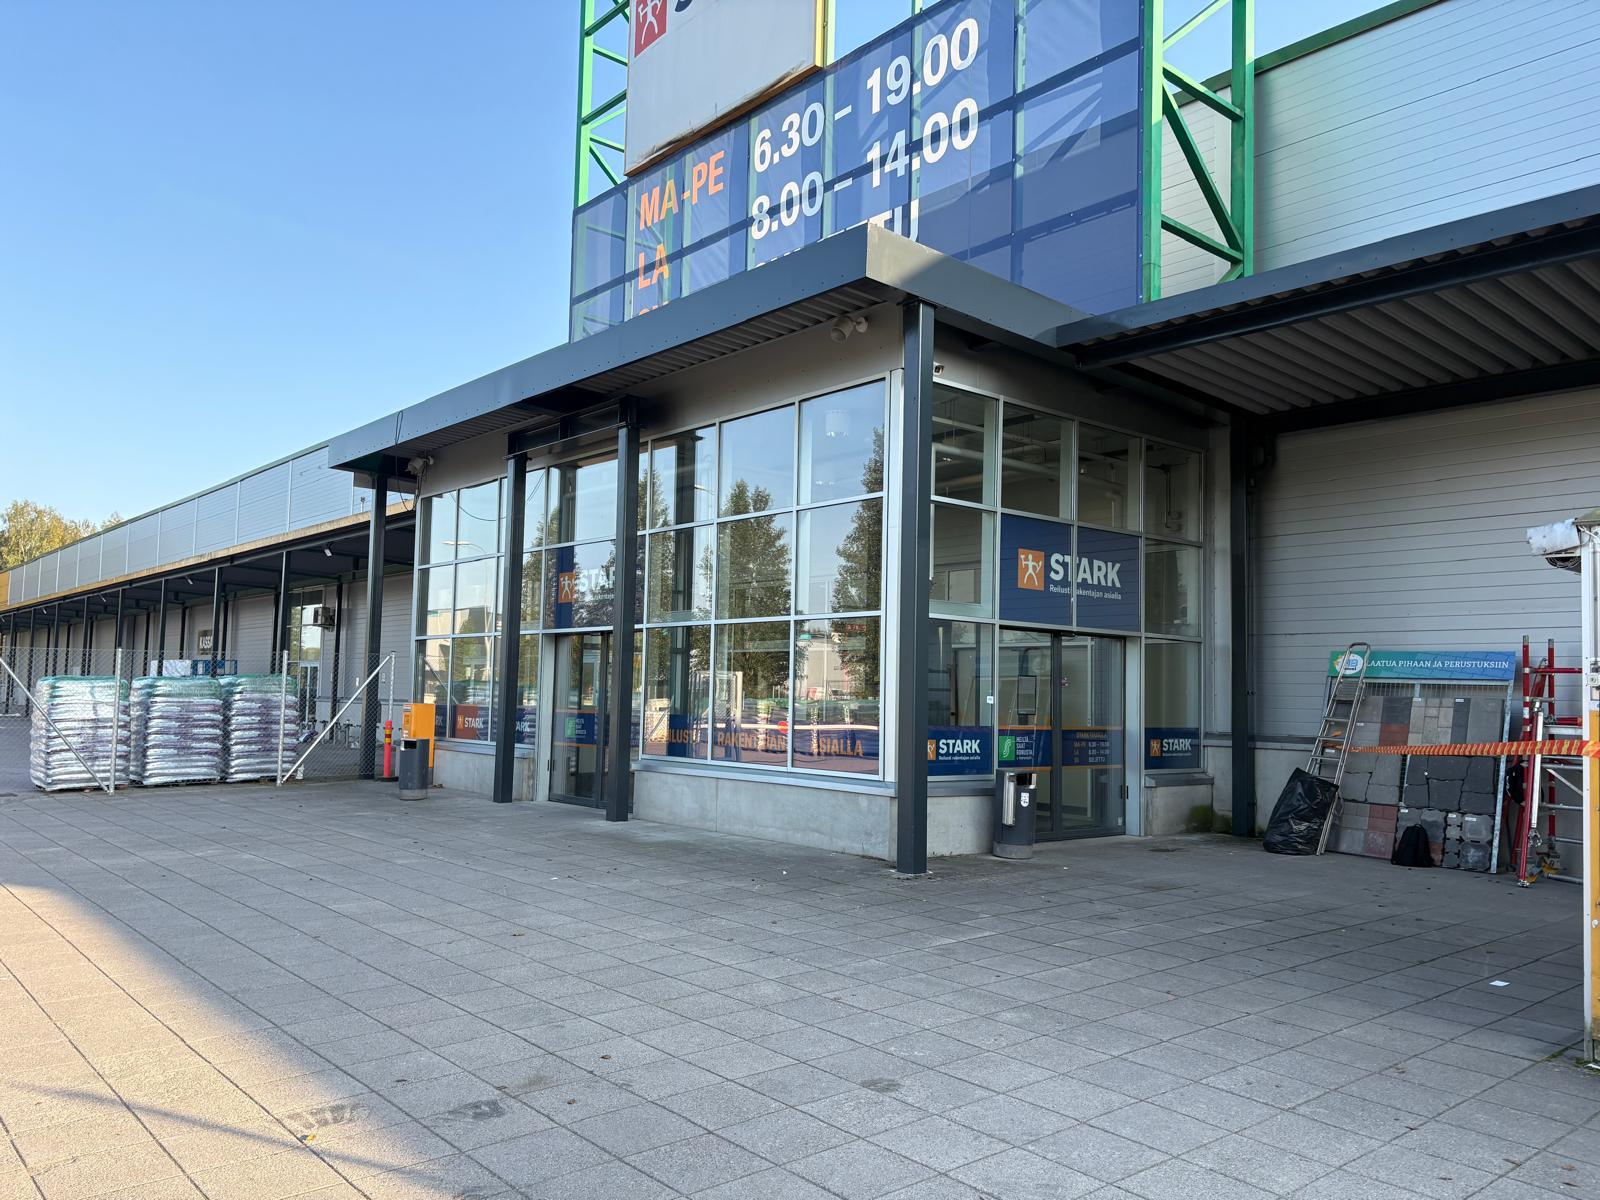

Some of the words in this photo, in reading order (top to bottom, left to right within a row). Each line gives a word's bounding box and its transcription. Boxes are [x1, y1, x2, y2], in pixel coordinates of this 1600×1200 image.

[639, 150, 725, 231] MA-PE
[754, 102, 825, 173] 6.30
[867, 18, 979, 115] 19.00
[638, 243, 670, 290] LA
[751, 171, 824, 240] 8.00
[867, 97, 979, 188] 14.00
[1398, 660, 1432, 668] PIHAAN
[1432, 660, 1443, 668] JA
[1444, 660, 1509, 669] PERUSTUKSIIN
[464, 717, 484, 729] STARK
[938, 739, 981, 754] STARK
[1162, 738, 1192, 751] STARK
